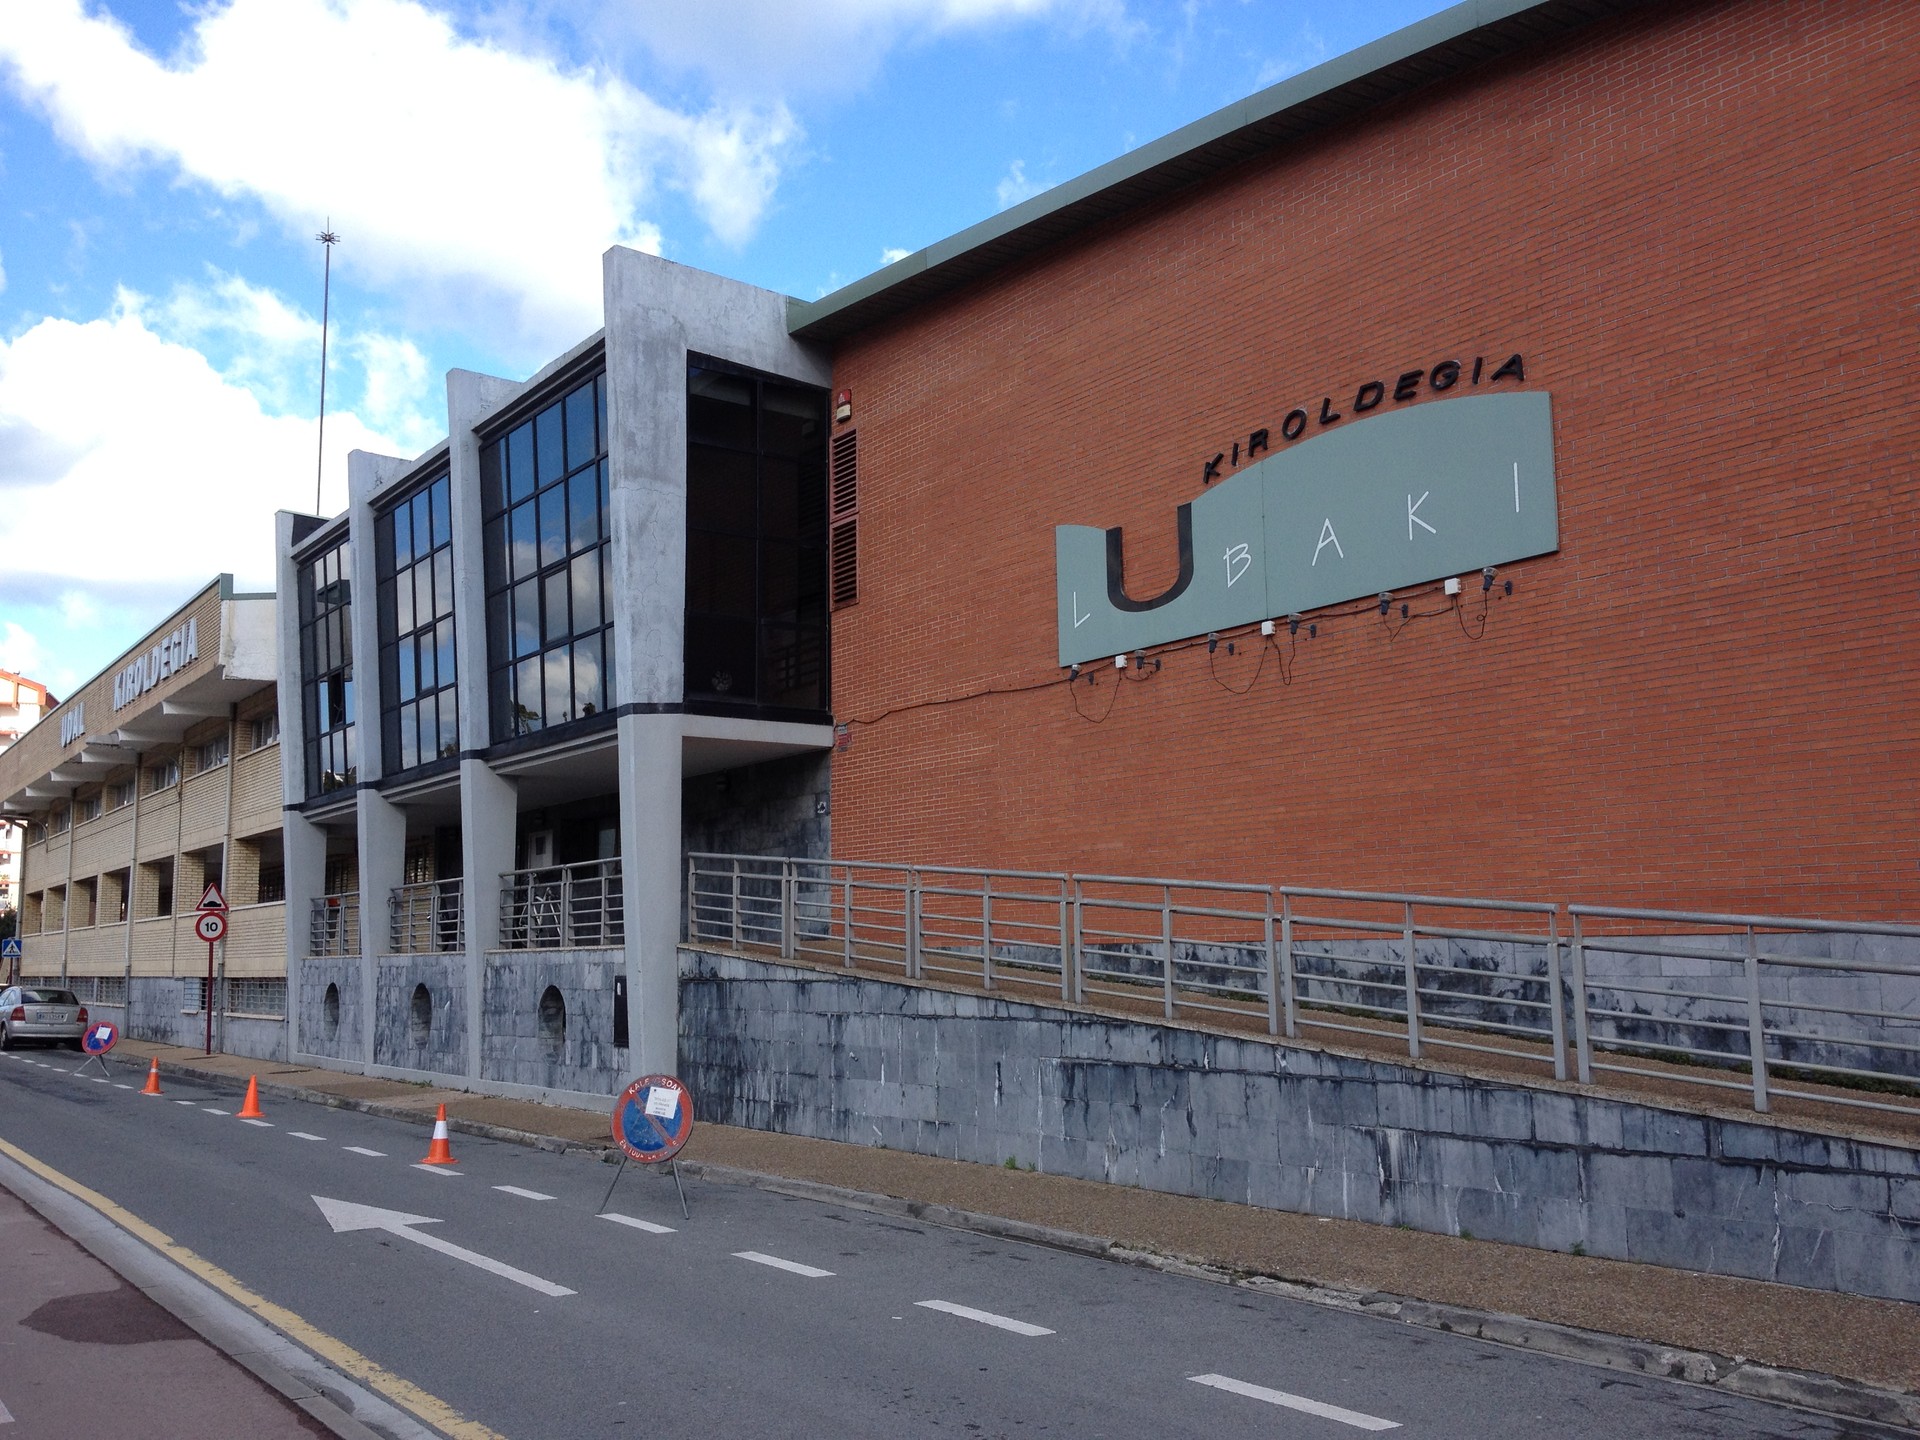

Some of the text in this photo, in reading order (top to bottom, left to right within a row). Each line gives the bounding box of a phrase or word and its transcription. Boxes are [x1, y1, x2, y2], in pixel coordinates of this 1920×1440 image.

[1203, 353, 1525, 484] KIROLDEGIA
[61, 617, 199, 748] UDAL KIROLDEGIA
[205, 922, 218, 932] 10
